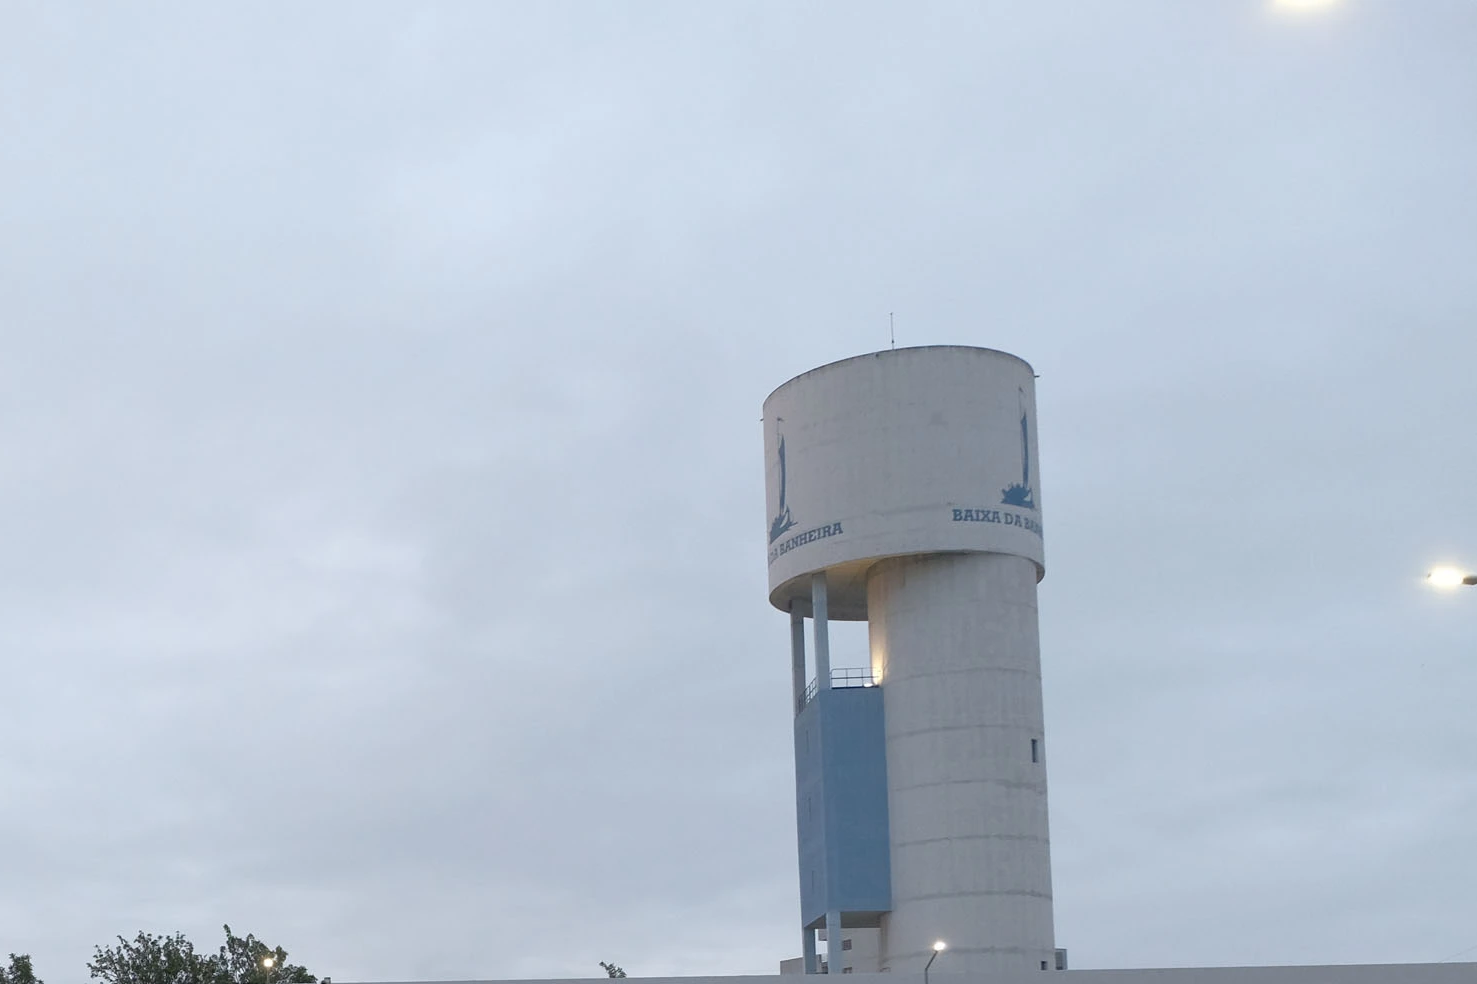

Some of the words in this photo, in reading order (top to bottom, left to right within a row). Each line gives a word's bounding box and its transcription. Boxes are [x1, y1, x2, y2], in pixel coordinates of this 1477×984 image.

[952, 509, 1001, 523] BAIXA
[1004, 513, 1022, 528] DA
[779, 522, 844, 557] BANHEIRA
